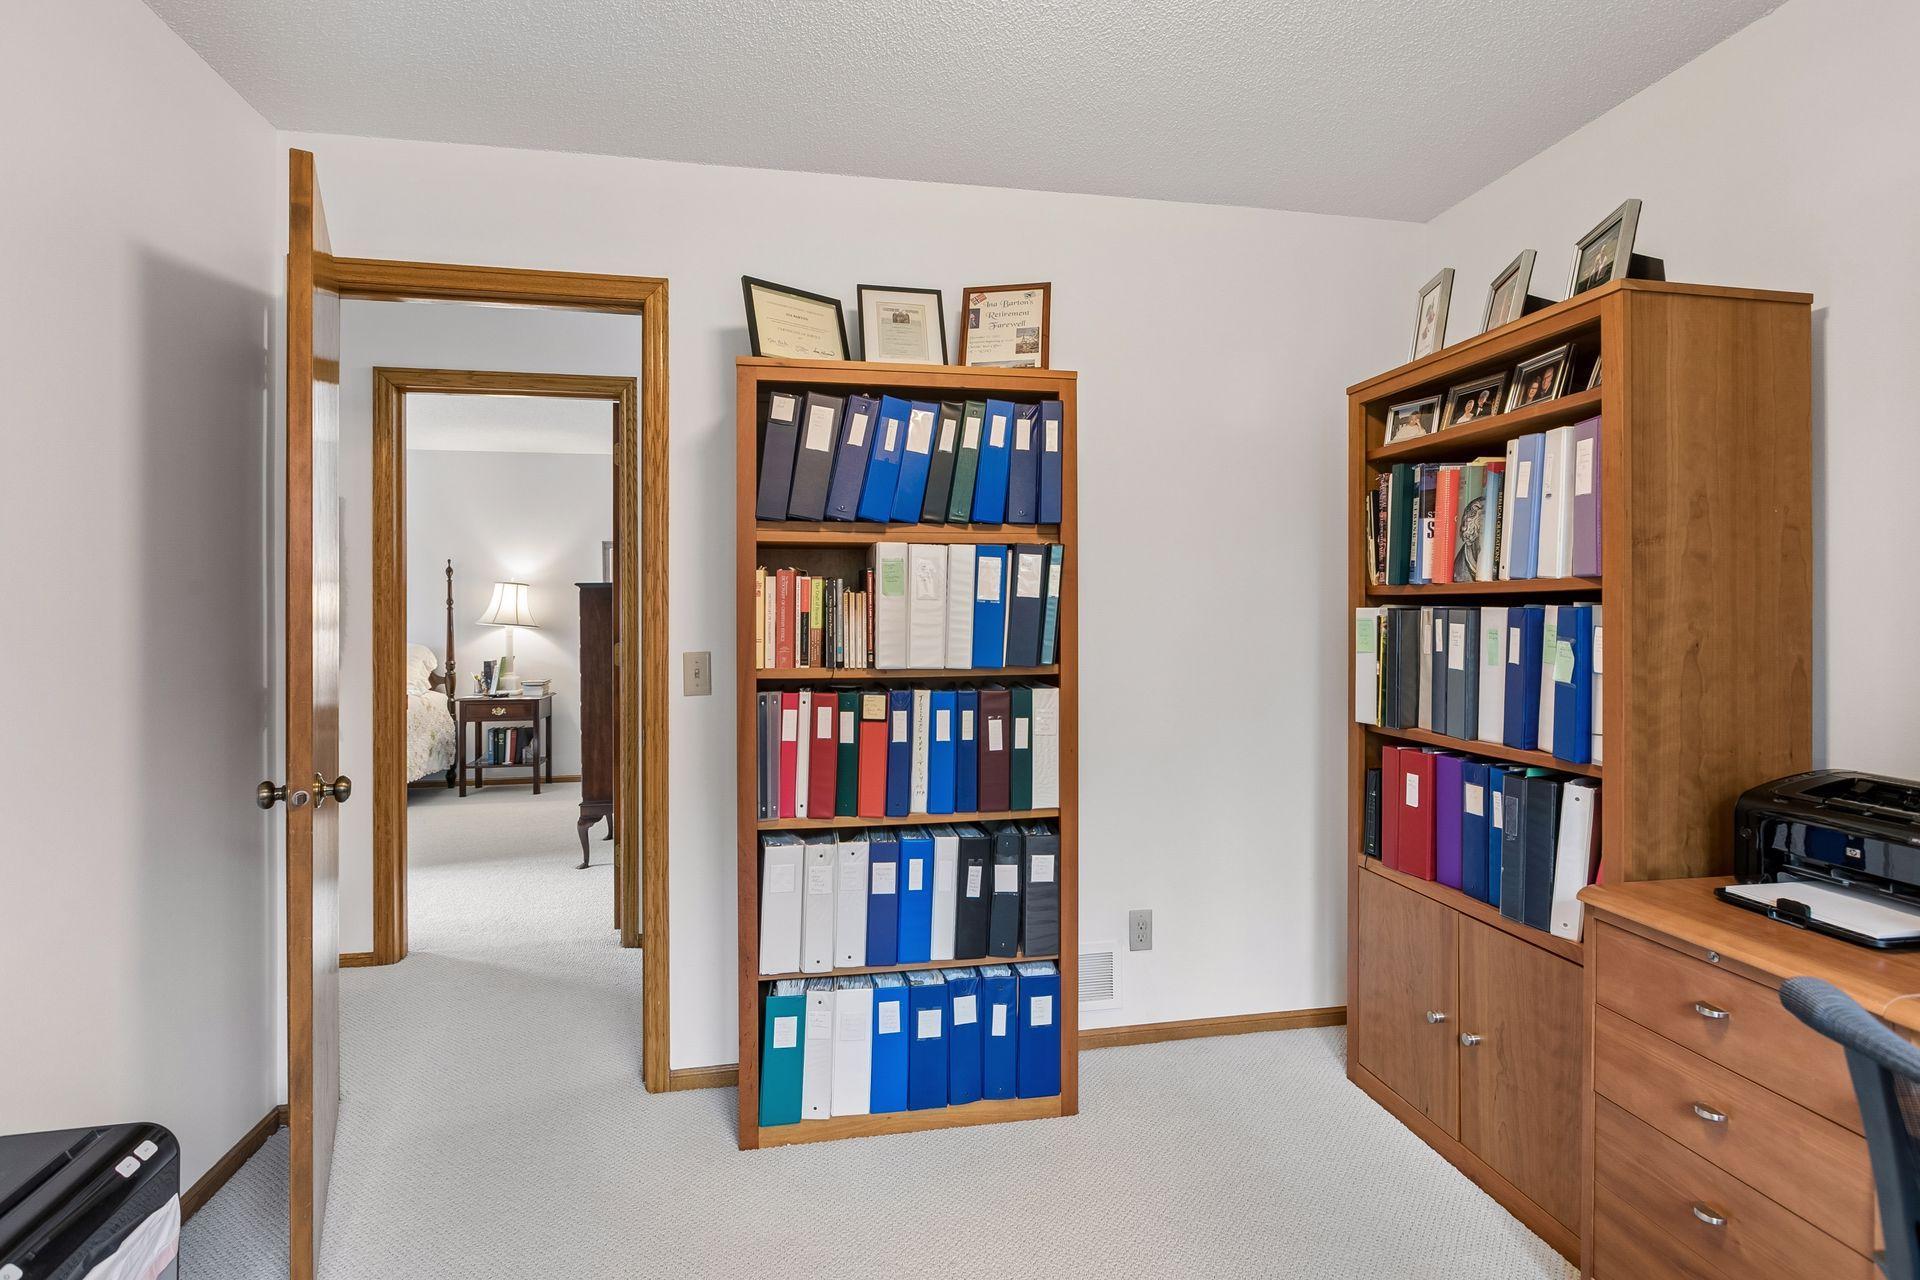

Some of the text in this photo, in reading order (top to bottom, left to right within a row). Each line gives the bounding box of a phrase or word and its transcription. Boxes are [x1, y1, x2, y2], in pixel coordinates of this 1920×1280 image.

[986, 310, 1030, 319] Retirement
[989, 320, 1026, 330] Farewell
[1494, 520, 1502, 562] QUOTATIONS
